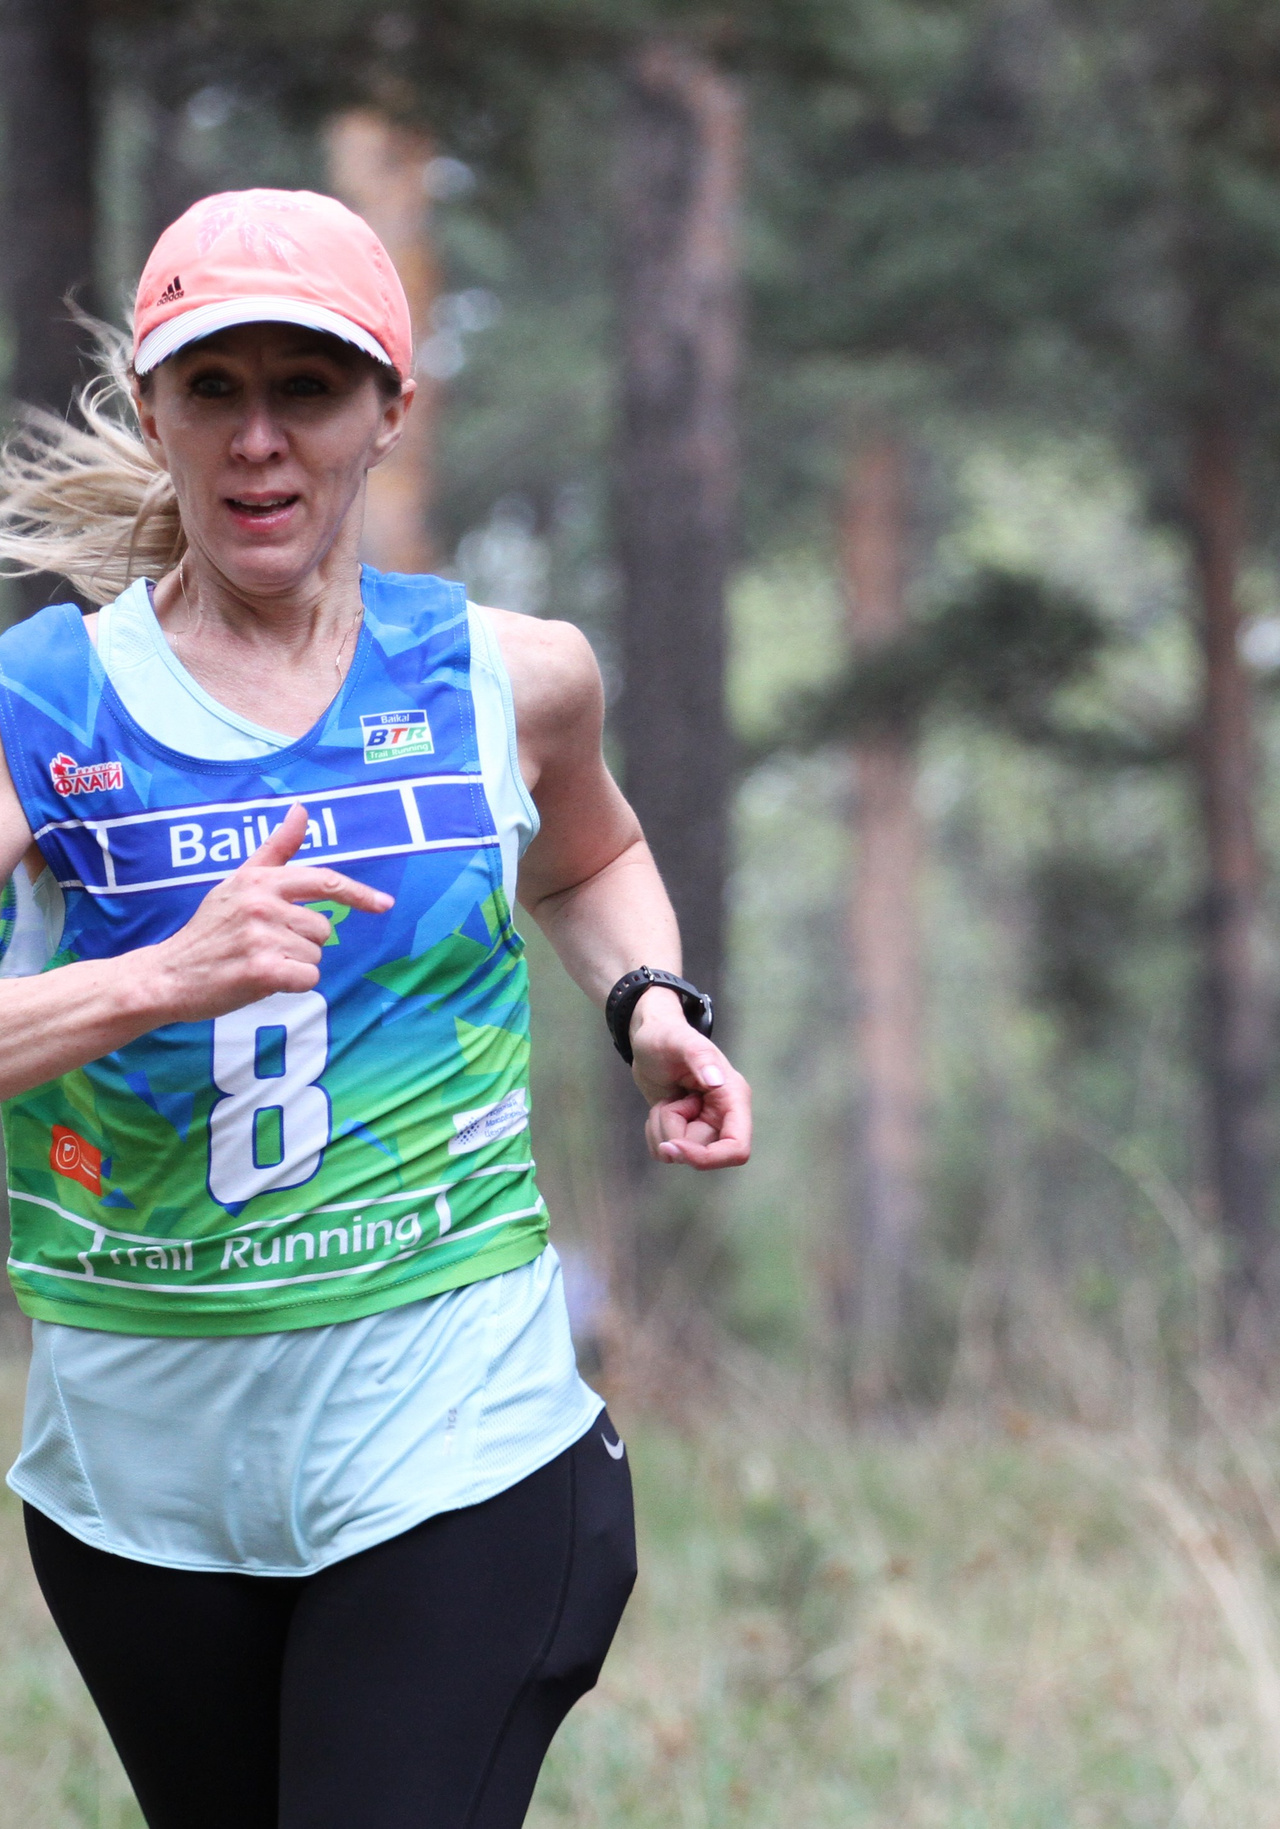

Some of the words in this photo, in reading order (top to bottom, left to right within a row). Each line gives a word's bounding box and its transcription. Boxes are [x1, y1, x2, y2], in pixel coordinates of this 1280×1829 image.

[157, 290, 184, 306] adidas
[381, 714, 410, 724] Baikal
[366, 727, 427, 747] BTR
[370, 750, 388, 759] Trail
[392, 743, 429, 756] Running
[208, 990, 332, 1206] 8
[221, 1212, 422, 1270] Running
